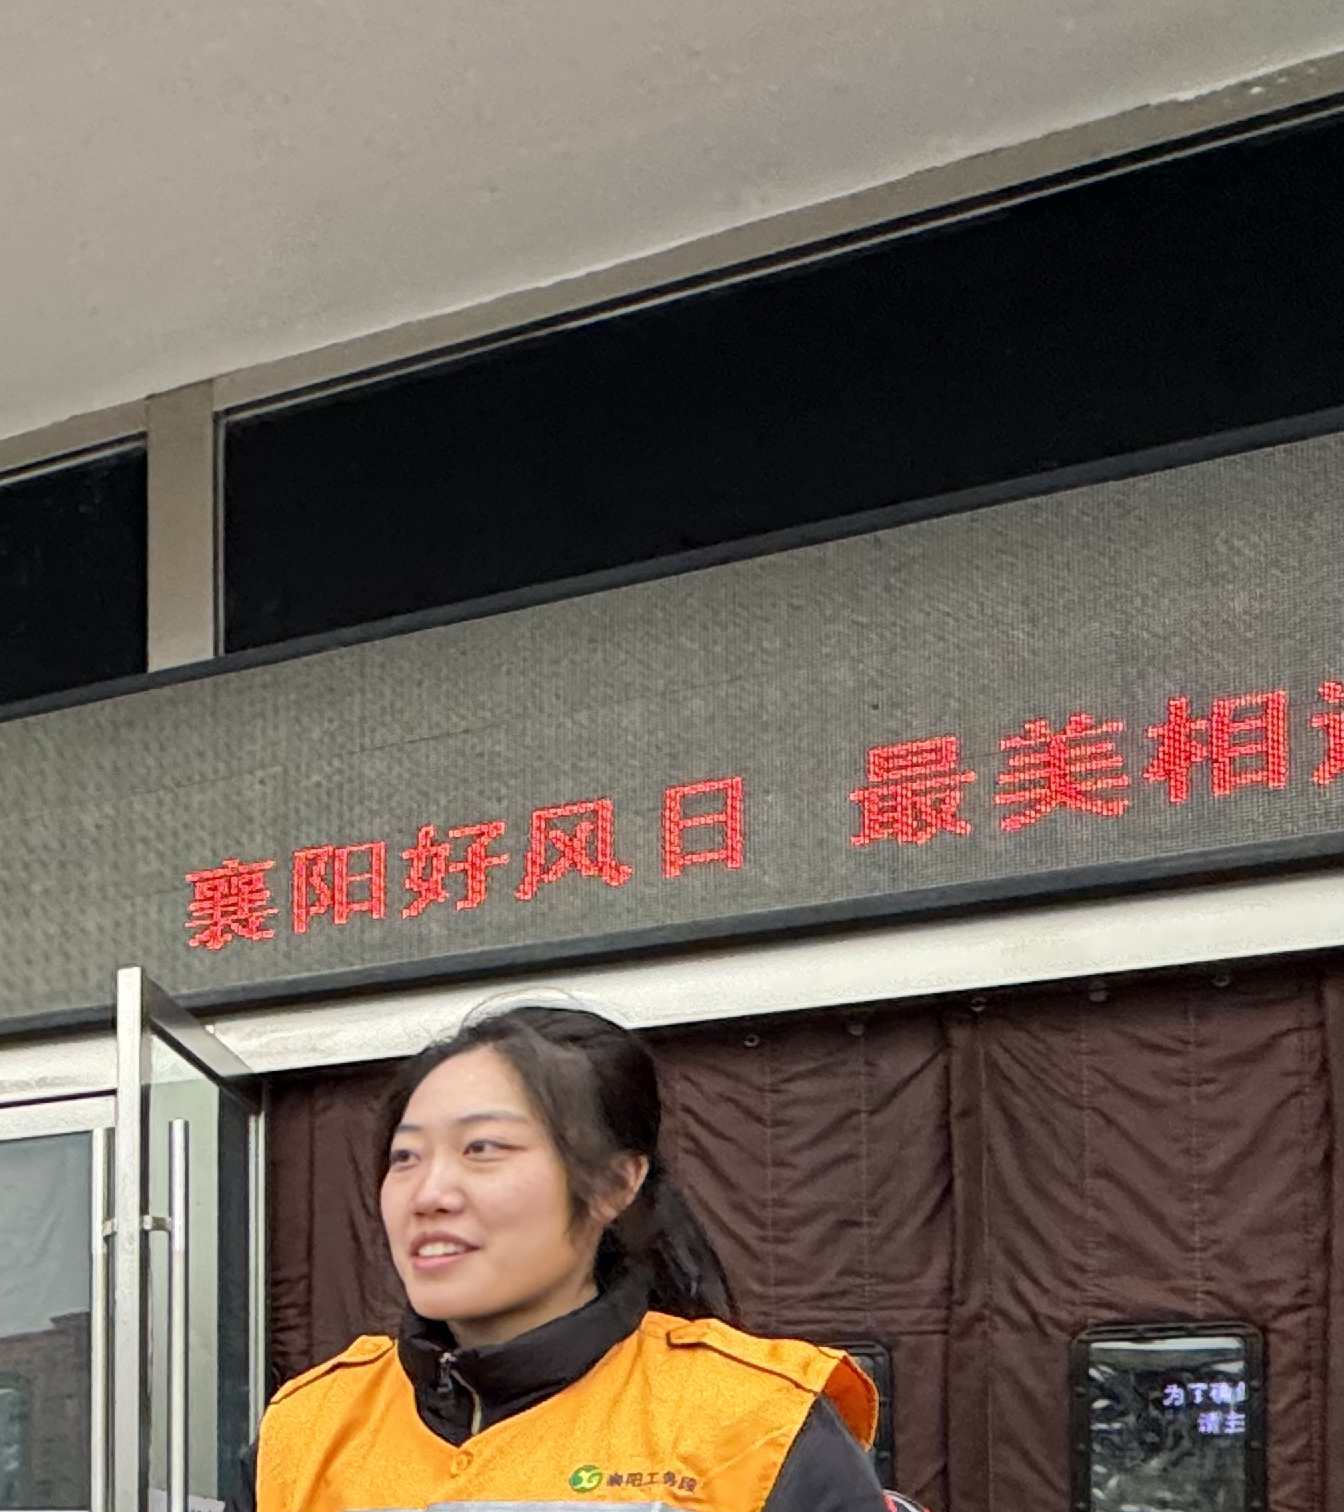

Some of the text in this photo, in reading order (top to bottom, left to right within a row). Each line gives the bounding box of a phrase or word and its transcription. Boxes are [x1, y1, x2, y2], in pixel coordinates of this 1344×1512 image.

[185, 775, 745, 950] 襄阳好风日
[850, 679, 1344, 847] 最美相
